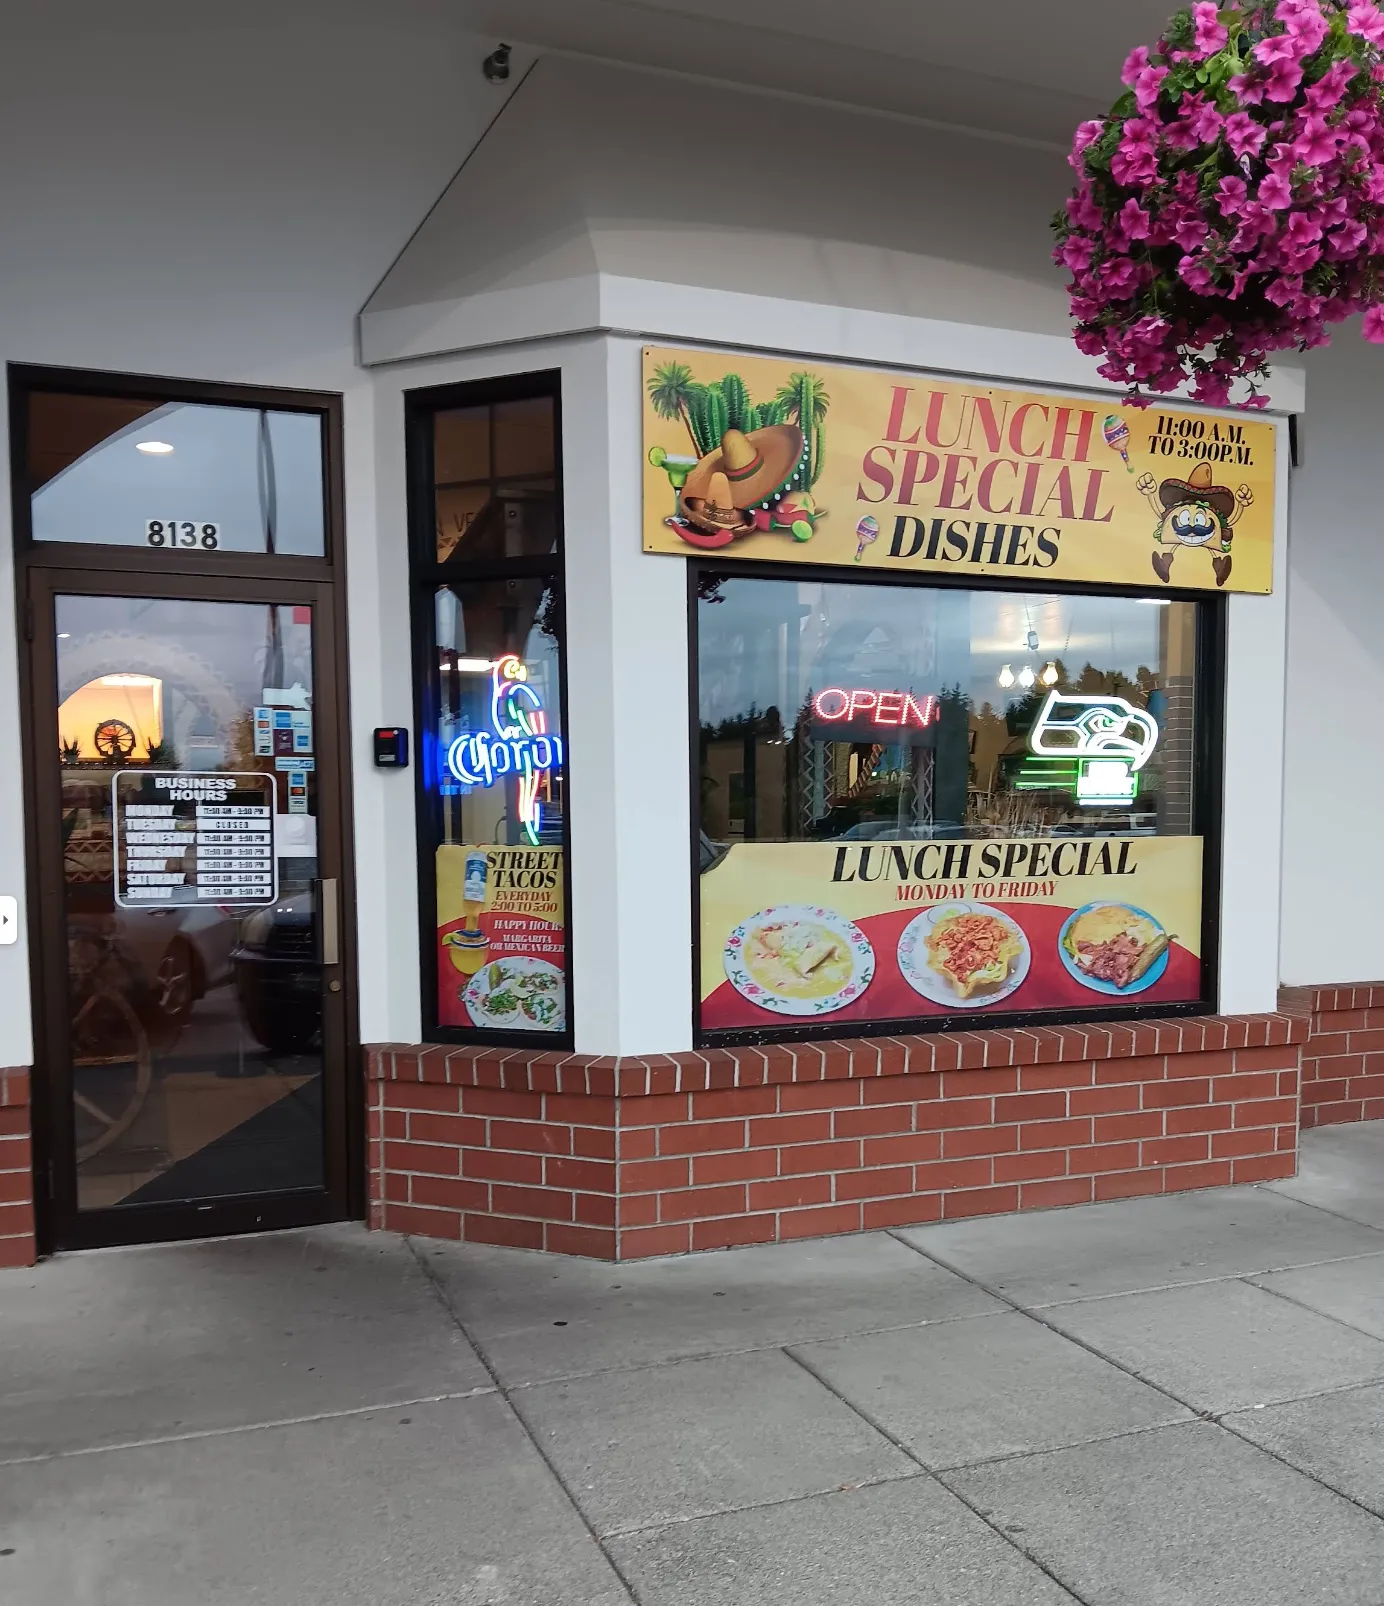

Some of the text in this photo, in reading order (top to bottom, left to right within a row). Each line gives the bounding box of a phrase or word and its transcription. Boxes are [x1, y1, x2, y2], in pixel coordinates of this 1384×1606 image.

[882, 386, 1098, 462] LUNCH
[1157, 415, 1246, 445] 11:00 A.M.
[1148, 435, 1174, 456] TO
[856, 445, 1115, 522] SPECIAL
[148, 520, 218, 549] 8138
[886, 515, 1061, 568] DISHES
[815, 687, 934, 726] OPEN
[155, 777, 237, 789] BUSINESS
[170, 789, 228, 801] HOURS
[486, 851, 564, 869] STREET
[829, 841, 1138, 882] LUNCH SPECIAL
[492, 870, 557, 888] TACOS
[895, 880, 1058, 901] MONDAY TO FRIDAY
[490, 901, 557, 912] 2:00 TO 5:00
[494, 919, 527, 930] HAPPY
[542, 944, 565, 952] BEER
